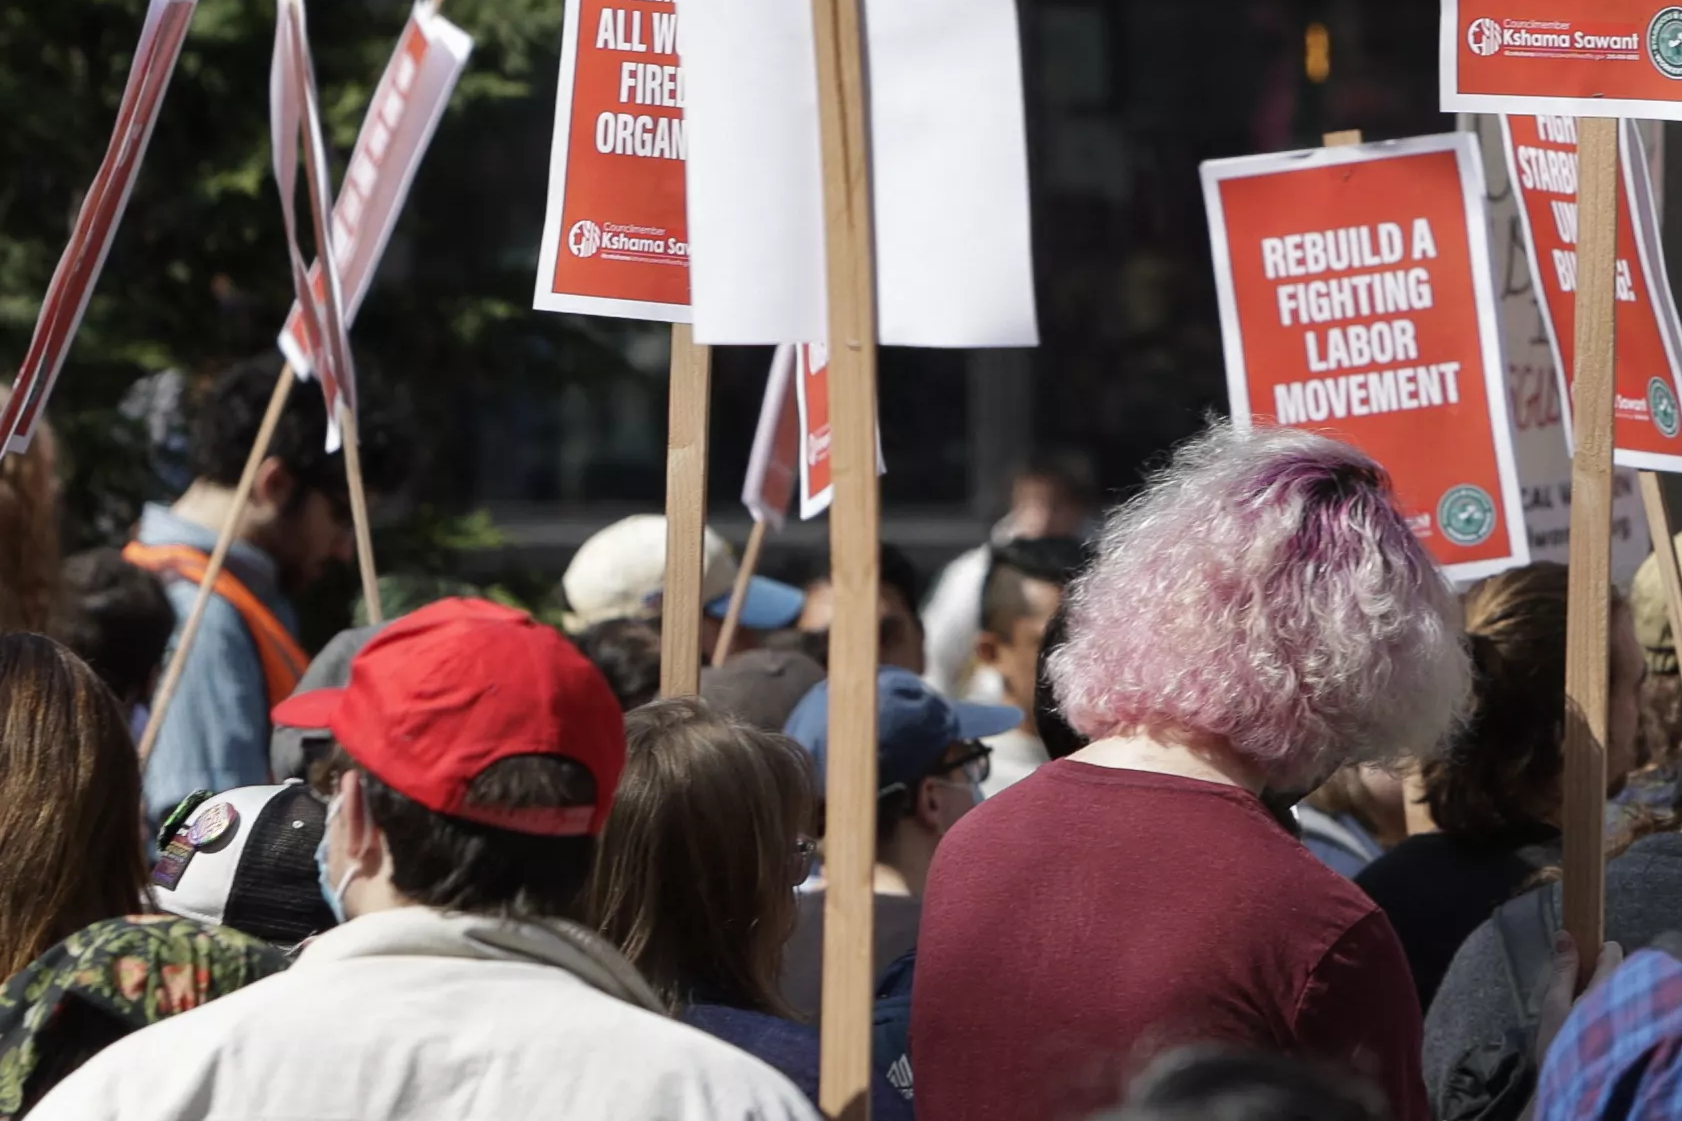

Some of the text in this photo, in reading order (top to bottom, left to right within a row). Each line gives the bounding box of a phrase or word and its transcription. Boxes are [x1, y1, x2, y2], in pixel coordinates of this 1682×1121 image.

[595, 7, 647, 52] ALL
[1503, 29, 1639, 49] Kshama Sawant
[601, 232, 664, 252] Kshama
[1262, 219, 1436, 278] REBUILD A
[1278, 268, 1432, 325] FIGHTING
[1306, 320, 1417, 371] LABOR
[1275, 362, 1459, 425] MOVEMENT
